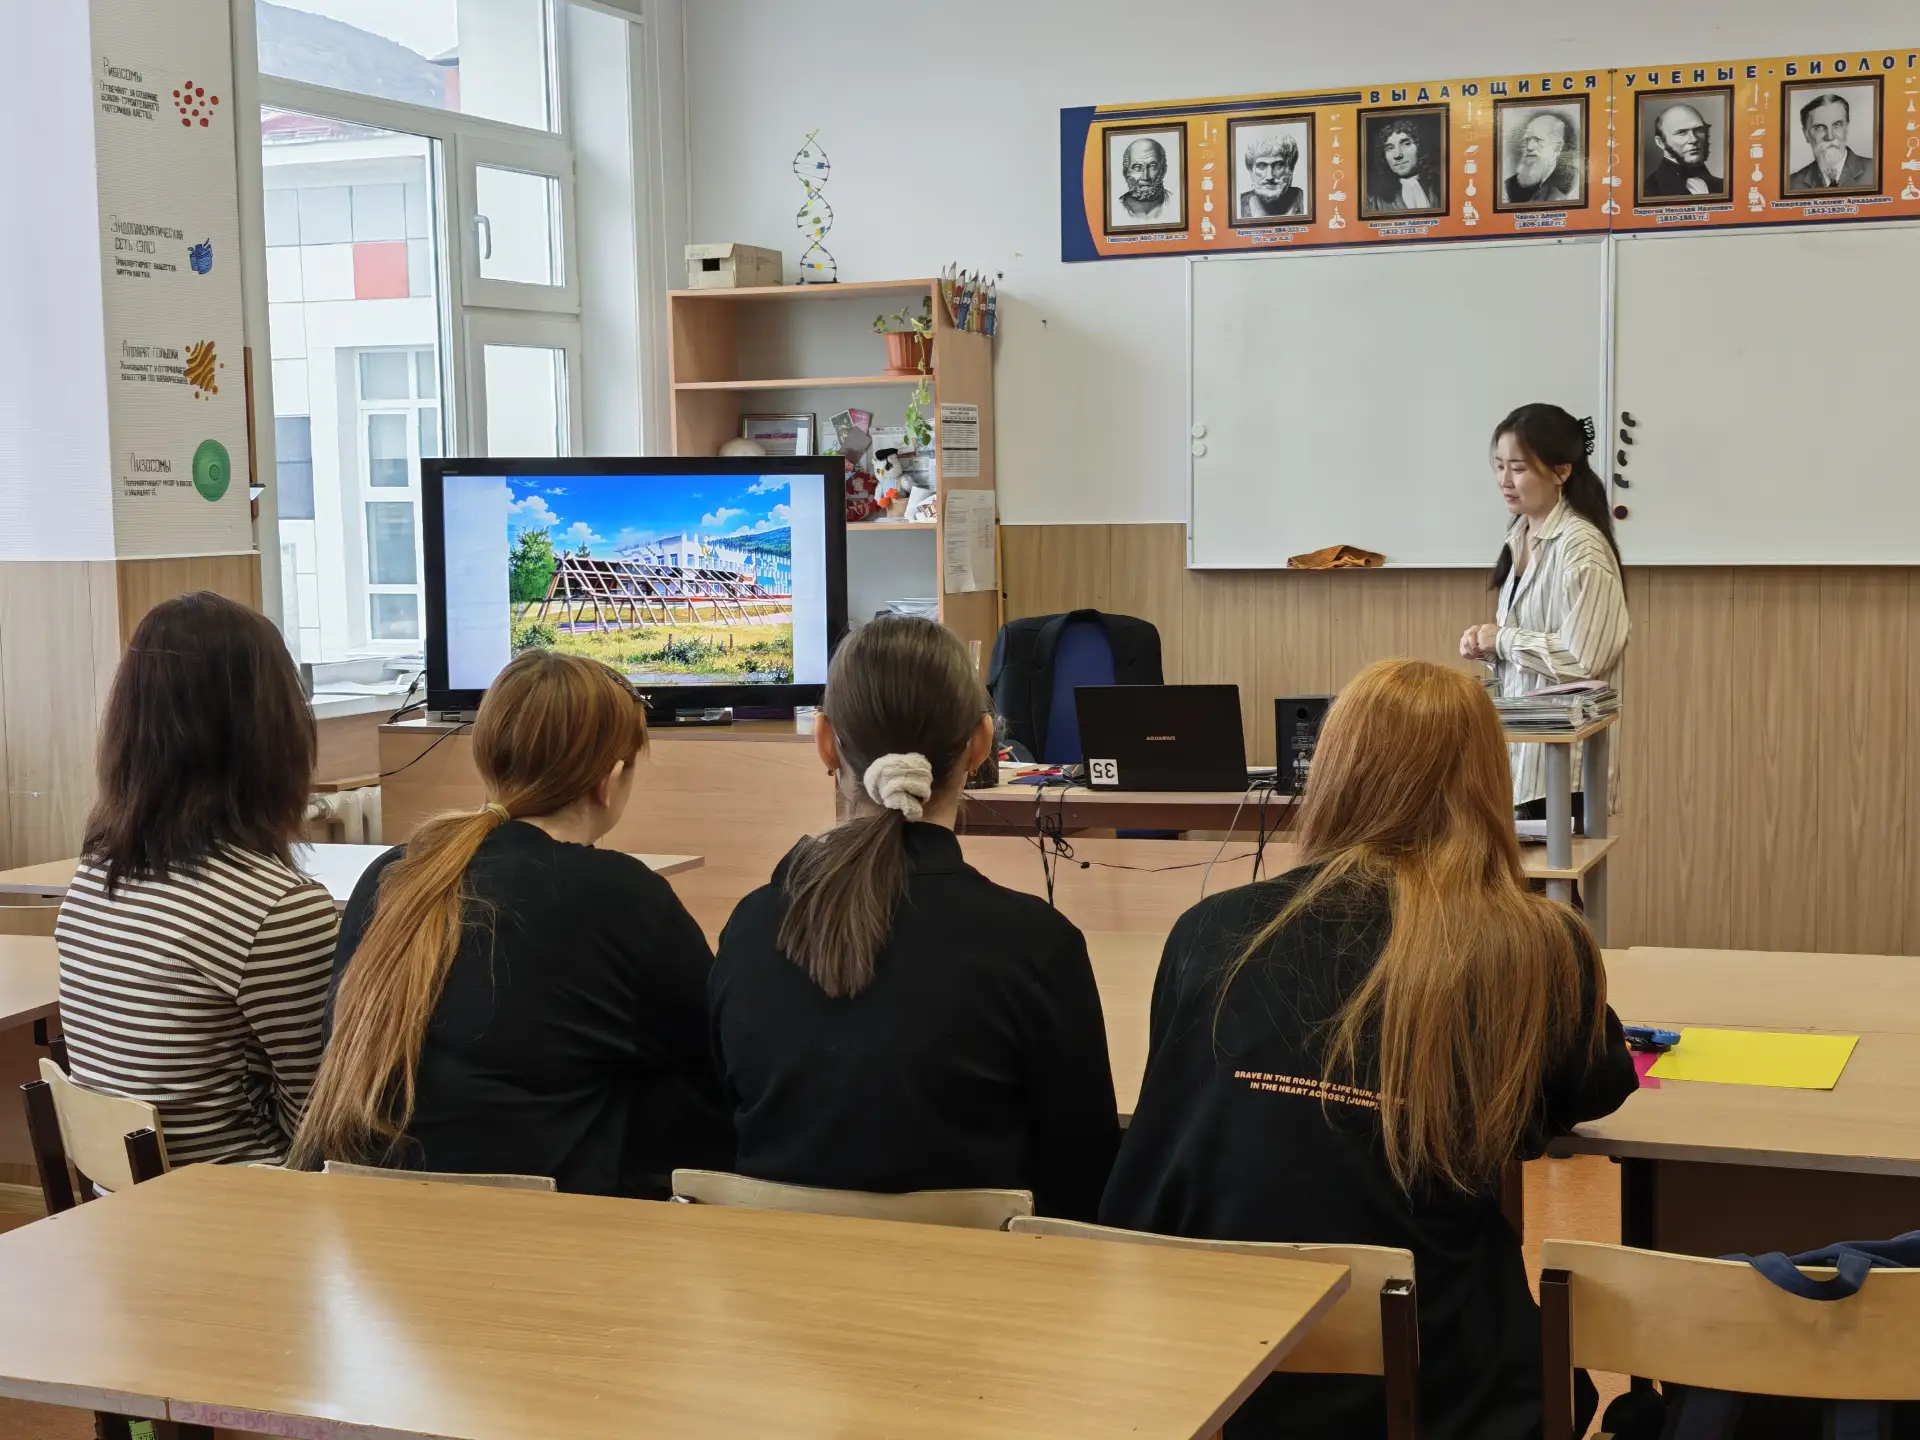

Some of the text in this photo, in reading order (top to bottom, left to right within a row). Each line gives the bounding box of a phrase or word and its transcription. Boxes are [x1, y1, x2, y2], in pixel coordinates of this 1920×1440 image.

[1369, 75, 1597, 103] ВЫДАЮЩИЕСЯ
[1092, 762, 1116, 779] 35
[1234, 1070, 1263, 1080] BRAVE
[1262, 1072, 1274, 1081] IN
[1274, 1074, 1292, 1083] THE
[1292, 1076, 1318, 1087] ROAD
[1319, 1081, 1332, 1090] OF
[1331, 1083, 1353, 1094] LIFE
[1249, 1081, 1260, 1090] IN
[1261, 1082, 1278, 1092] THE
[1278, 1085, 1309, 1096] HEART
[1308, 1088, 1346, 1103] ACROSS
